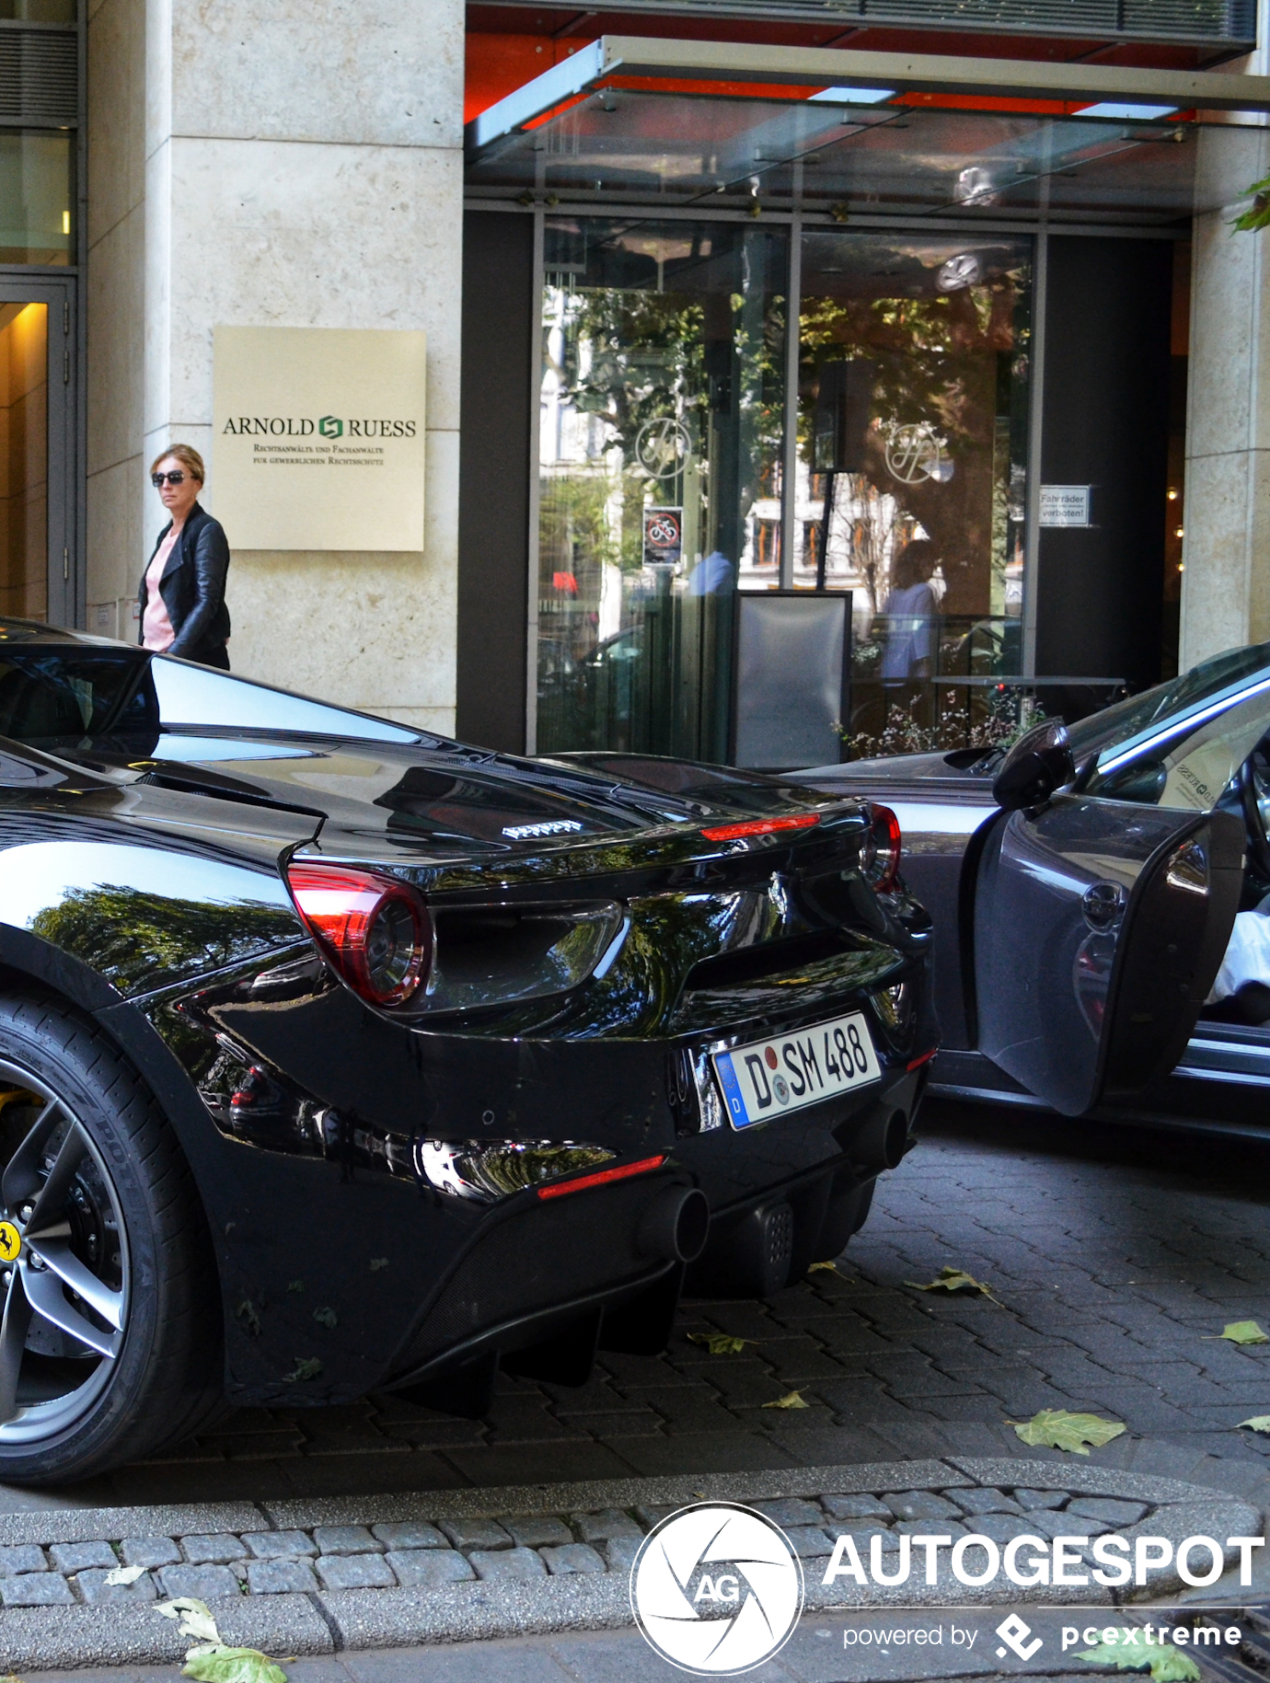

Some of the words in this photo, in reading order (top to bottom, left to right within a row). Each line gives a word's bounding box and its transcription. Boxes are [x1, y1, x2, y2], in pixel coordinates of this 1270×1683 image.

[222, 416, 315, 436] ARNOLD
[347, 418, 417, 438] RUESS
[744, 1053, 773, 1110] D
[782, 1037, 825, 1097] SM
[823, 1023, 868, 1083] 488
[731, 1097, 741, 1114] D
